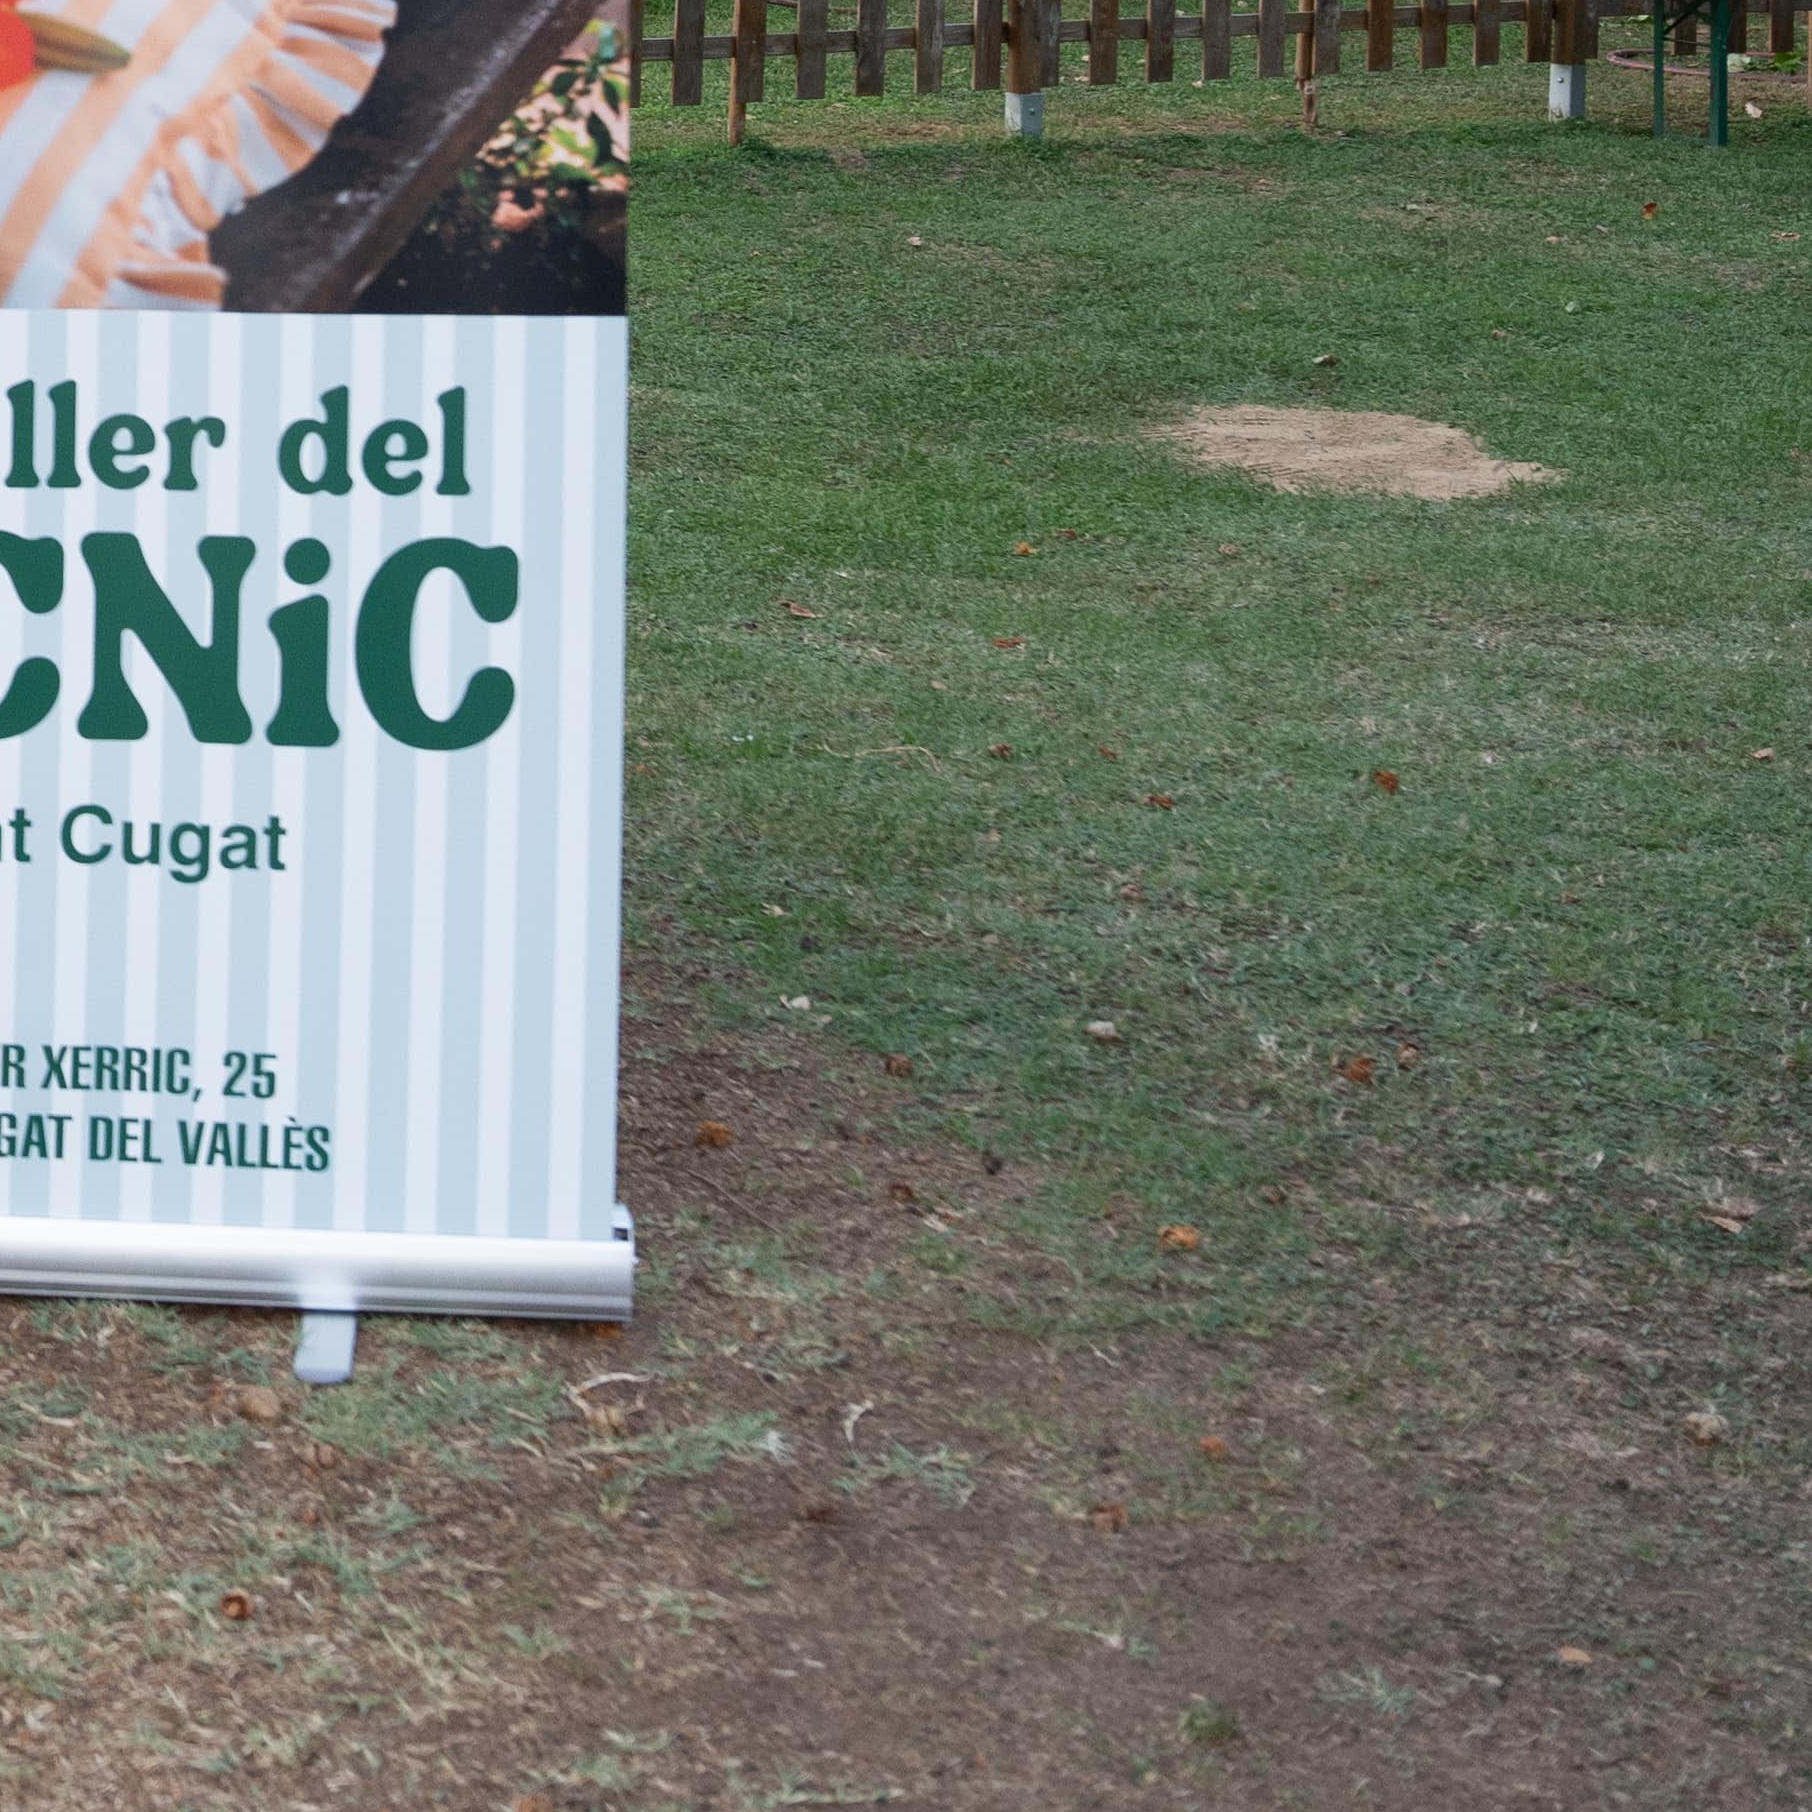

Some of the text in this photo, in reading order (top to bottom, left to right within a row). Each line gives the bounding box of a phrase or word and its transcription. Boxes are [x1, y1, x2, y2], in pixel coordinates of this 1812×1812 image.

[277, 384, 472, 497] del
[60, 803, 288, 884] Cugat
[40, 1044, 203, 1102] XERRIC,
[222, 1051, 278, 1100] 25
[87, 1115, 164, 1165] DEL
[177, 1117, 332, 1173] VALLÈS
